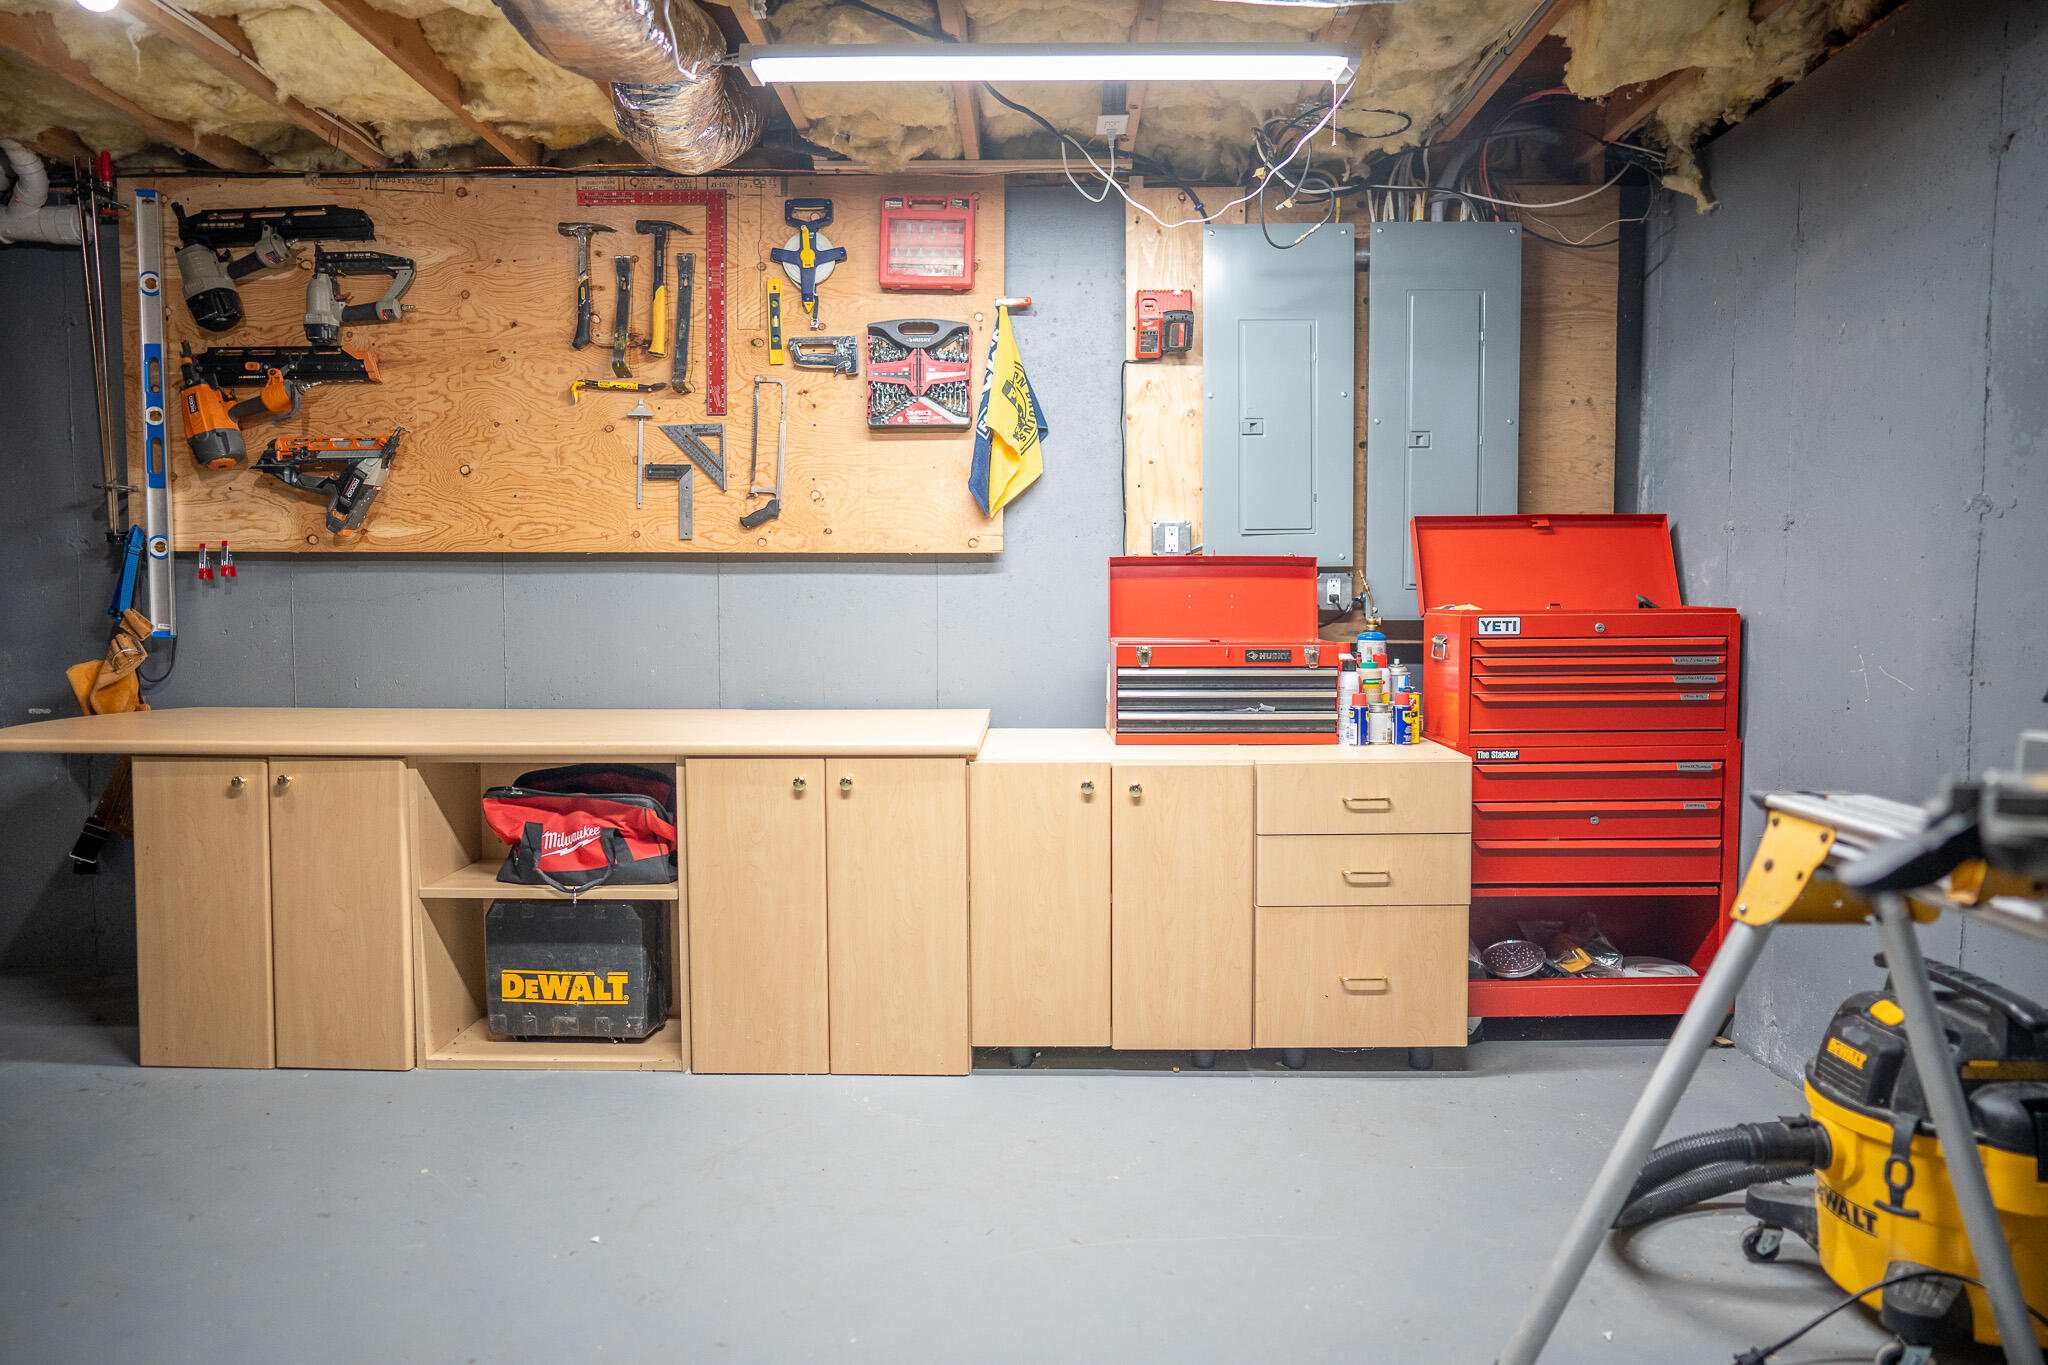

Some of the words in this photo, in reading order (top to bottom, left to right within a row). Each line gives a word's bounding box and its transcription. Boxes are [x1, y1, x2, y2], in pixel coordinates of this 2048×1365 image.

[1481, 620, 1517, 633] YETI
[1259, 652, 1289, 660] HUSKY
[1477, 750, 1490, 759] The
[1491, 750, 1517, 759] Stacker
[542, 825, 601, 850] Milwaukee
